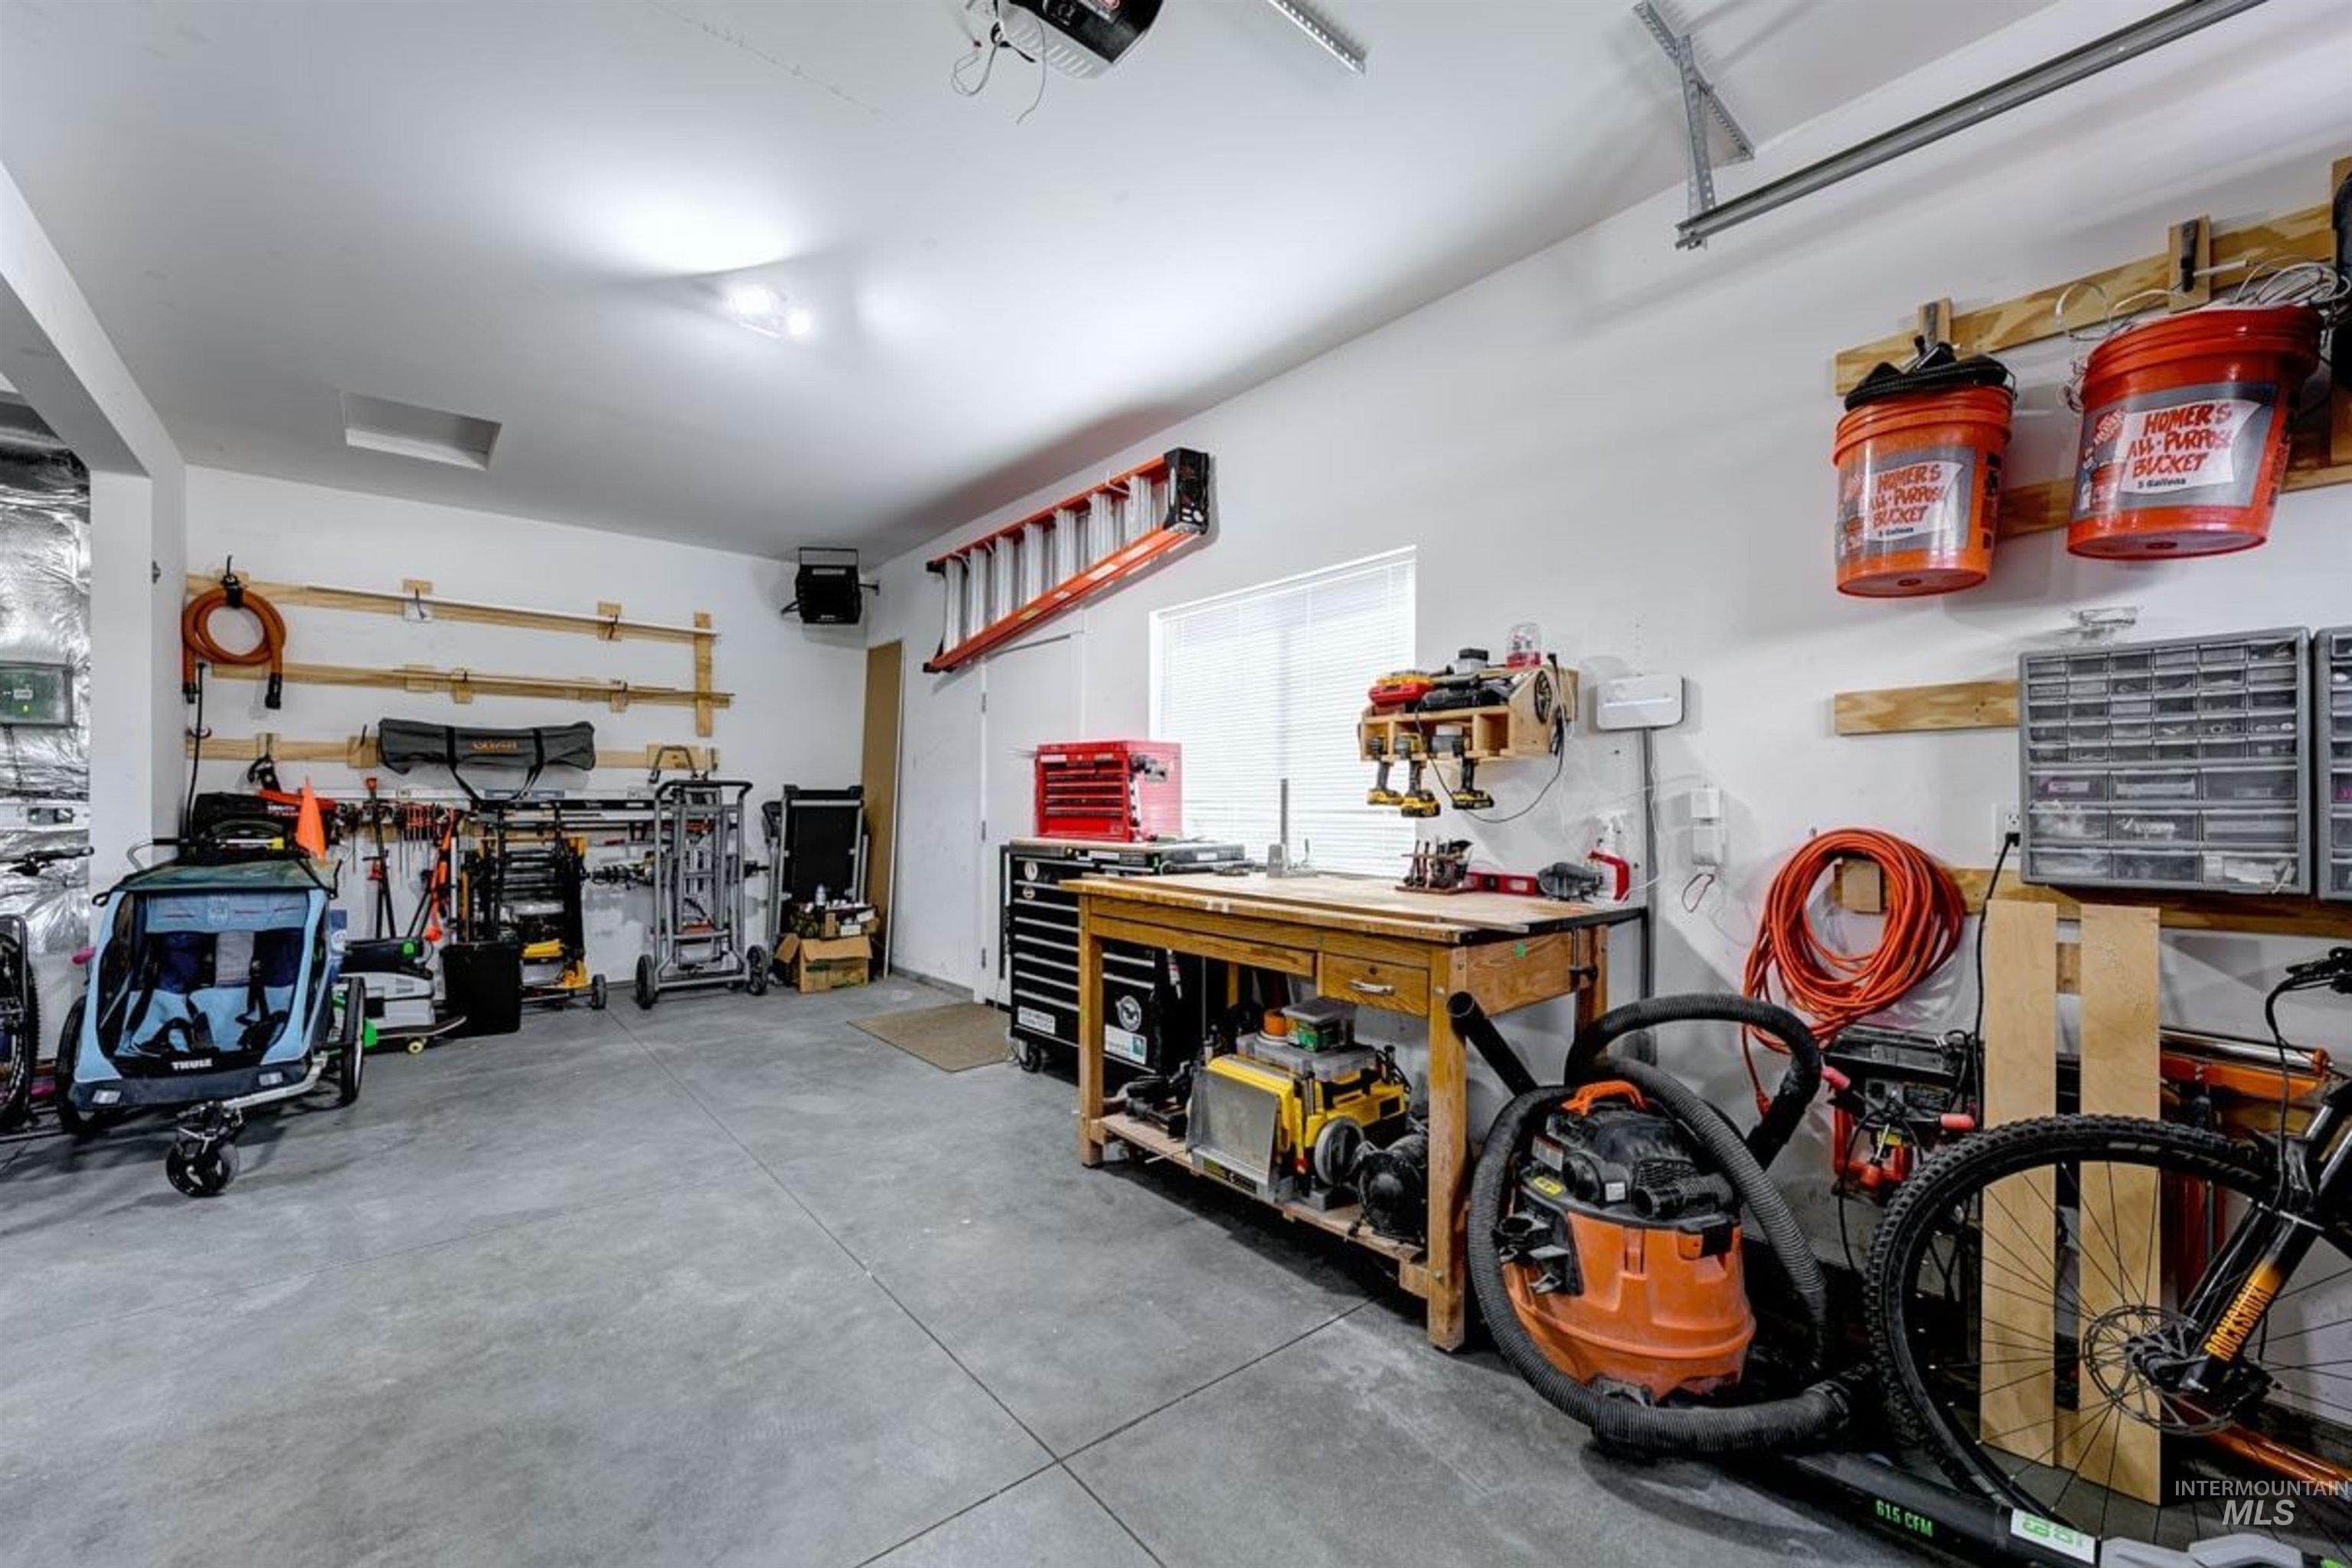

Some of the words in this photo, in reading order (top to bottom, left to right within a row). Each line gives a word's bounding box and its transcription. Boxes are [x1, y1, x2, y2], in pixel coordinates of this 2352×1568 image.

[2133, 452, 2209, 479] BUCKET
[172, 1057, 213, 1070] THULE
[1876, 1499, 1900, 1524] 615
[1904, 1511, 1934, 1537] CFM
